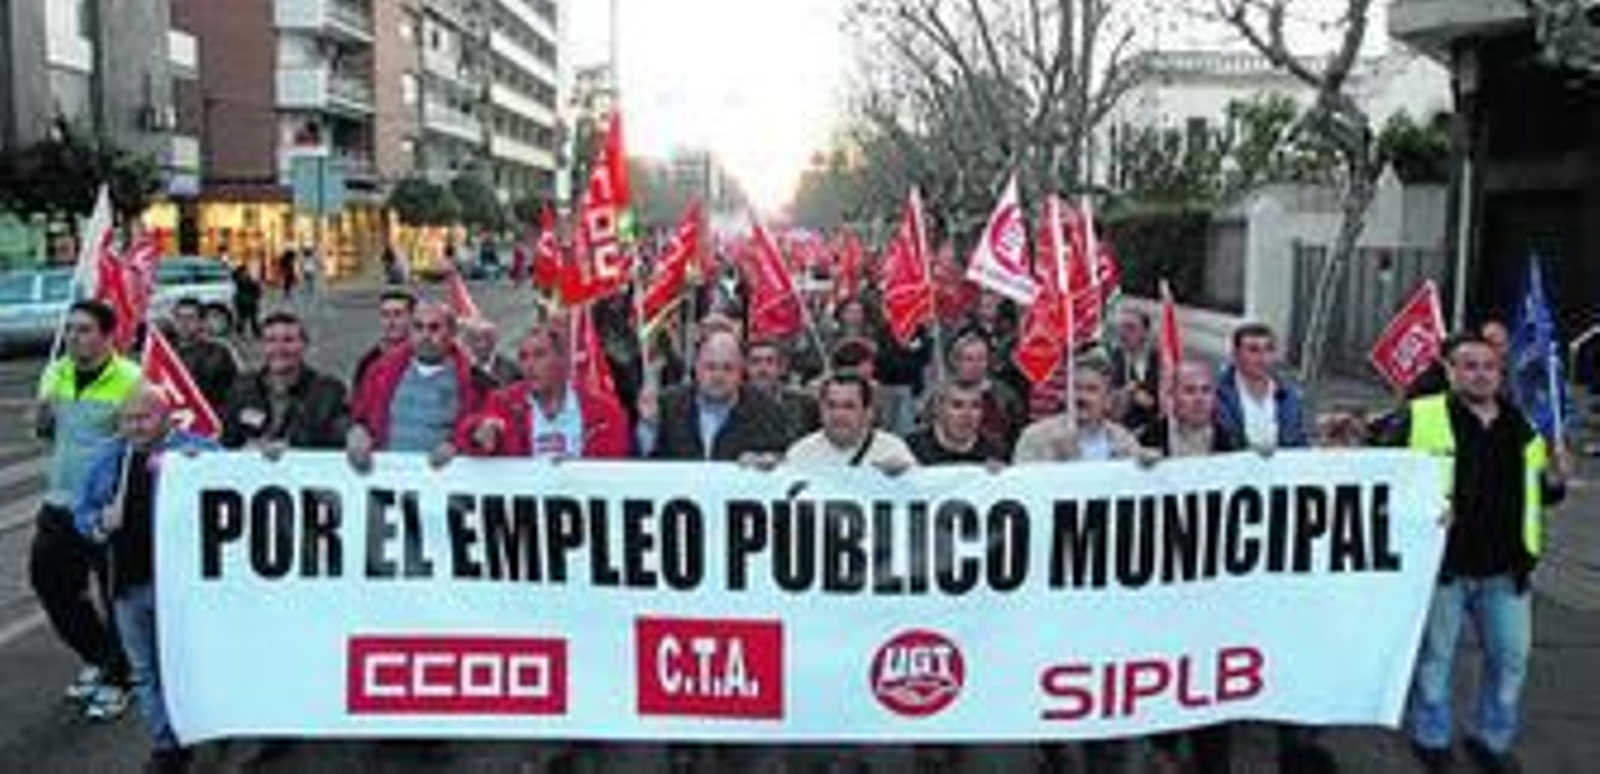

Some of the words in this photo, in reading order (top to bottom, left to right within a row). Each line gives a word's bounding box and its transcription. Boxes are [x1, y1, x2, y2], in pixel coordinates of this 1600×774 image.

[201, 486, 342, 579] POR
[365, 487, 433, 577] EL
[449, 494, 702, 588] EMPLEO
[727, 482, 1030, 595] PÚBLICO
[1050, 483, 1401, 590] MUNICIPAL
[363, 653, 550, 697] CCOO
[656, 636, 758, 697] C.T.A.
[881, 645, 954, 677] UGT
[1041, 646, 1265, 721] SIPLB
